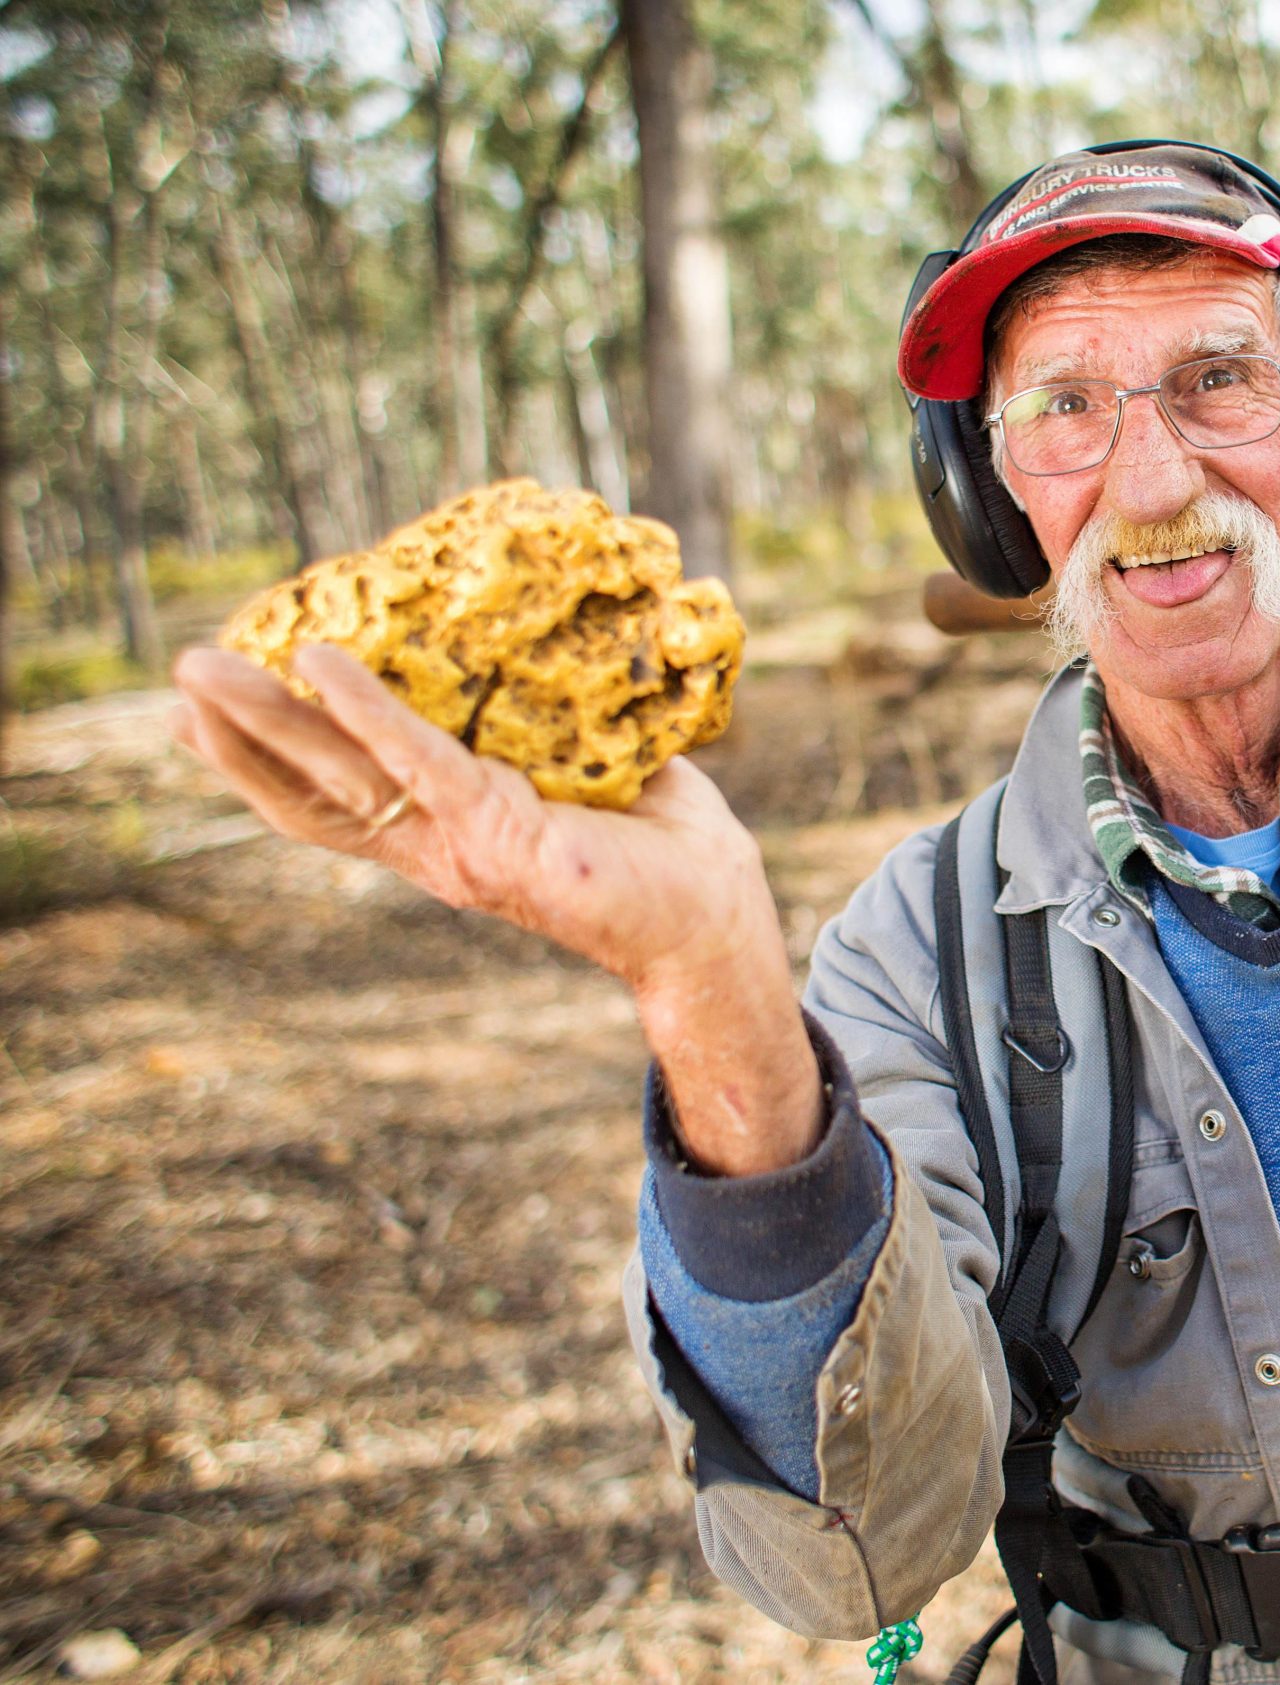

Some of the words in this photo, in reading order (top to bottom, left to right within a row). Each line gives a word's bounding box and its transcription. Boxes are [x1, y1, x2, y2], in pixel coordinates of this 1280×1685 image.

[1081, 164, 1178, 178] TRUCKS
[1016, 205, 1048, 228] AND
[1049, 184, 1117, 209] SERVICE
[1118, 180, 1185, 190] CENTRE
